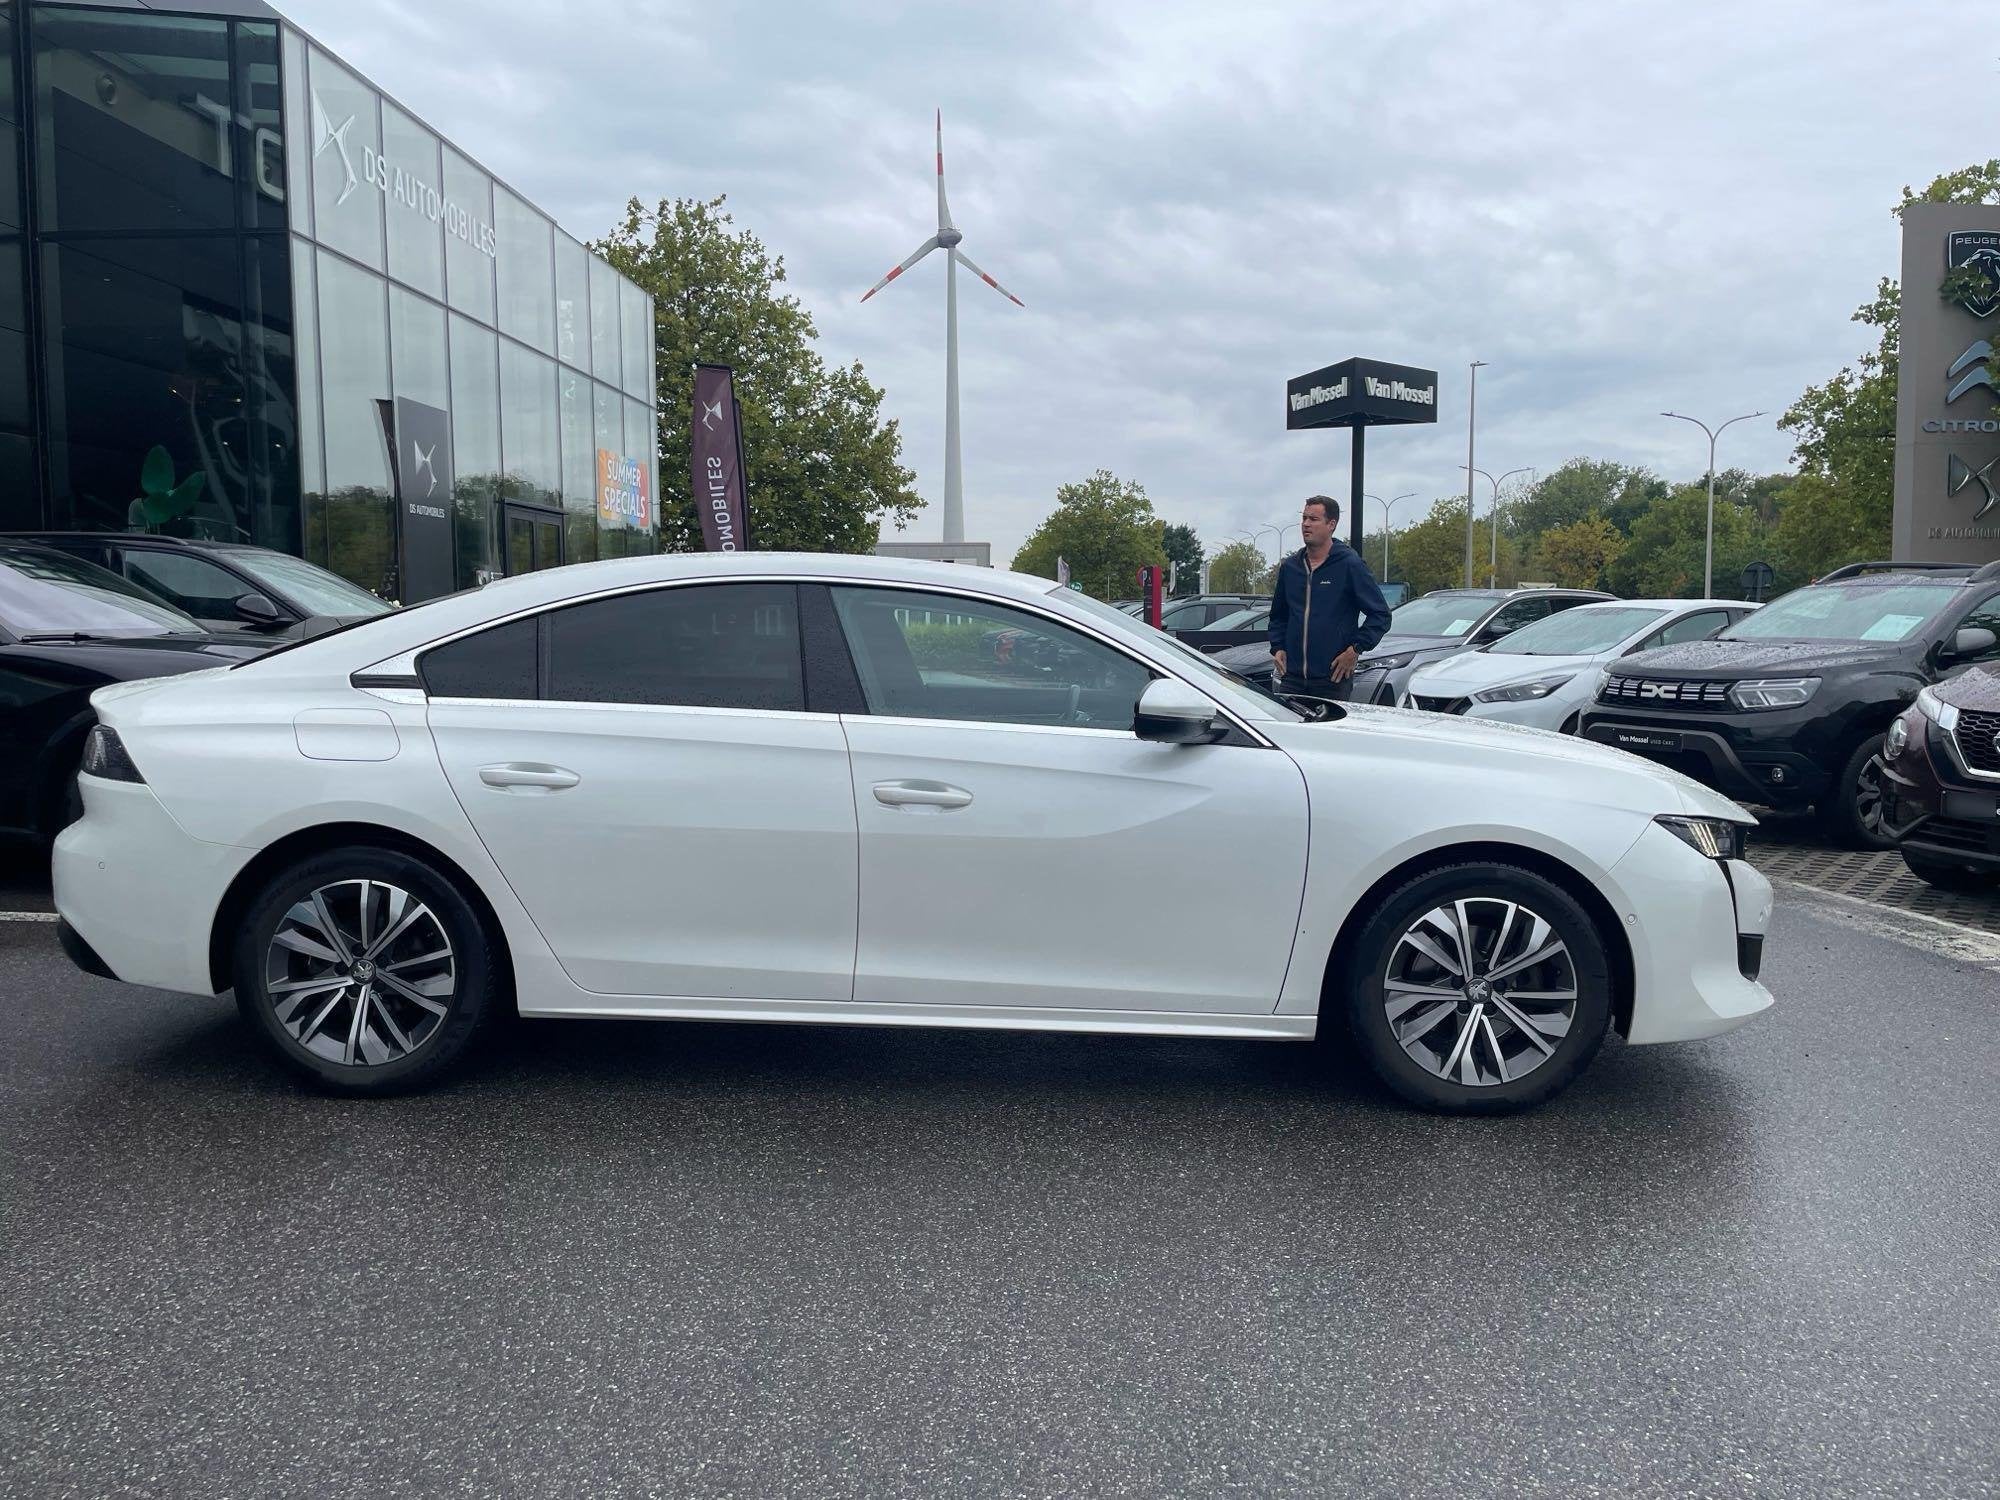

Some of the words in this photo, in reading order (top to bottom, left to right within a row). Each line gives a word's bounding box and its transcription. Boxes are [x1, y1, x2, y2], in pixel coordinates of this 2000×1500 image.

[363, 145, 387, 191] DS
[393, 167, 496, 258] AUTOMOBILES
[1955, 237, 2000, 246] PEUGE
[1290, 392, 1310, 412] Van
[1310, 376, 1348, 407] Mossel
[1364, 376, 1391, 399] Van
[1390, 380, 1434, 405] Mossel
[1921, 419, 2000, 433] CITRO
[606, 458, 642, 489] SUMMER
[409, 503, 417, 514] DS
[416, 504, 445, 518] AUTOMOBILES
[603, 486, 647, 519] SPECIALS
[1619, 734, 1630, 742] Van
[1630, 735, 1649, 744] Mossel
